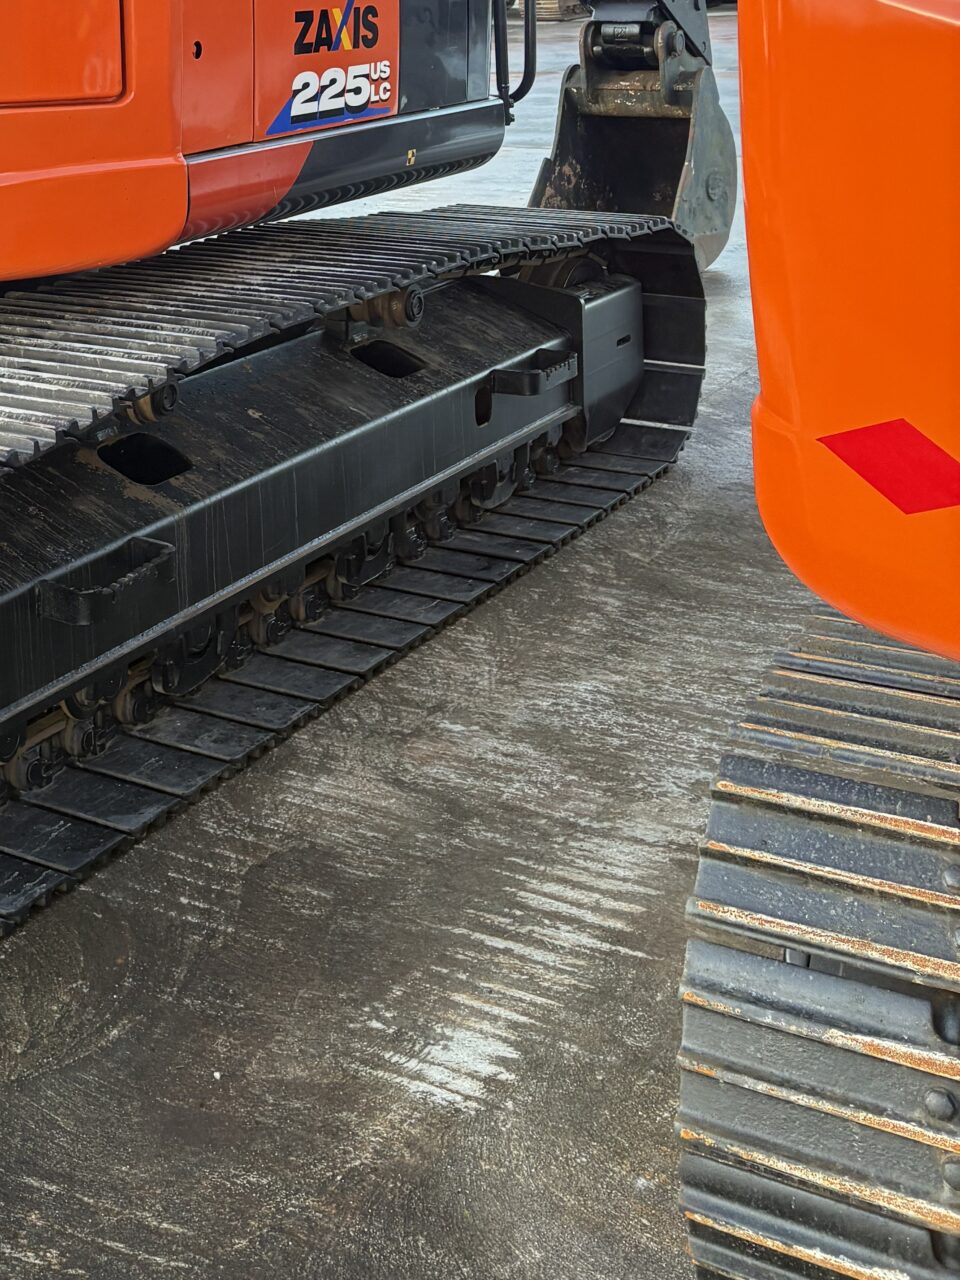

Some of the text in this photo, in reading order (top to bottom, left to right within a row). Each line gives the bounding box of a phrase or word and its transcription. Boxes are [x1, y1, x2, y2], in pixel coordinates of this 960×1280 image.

[290, 60, 391, 122] 225 US
[370, 82, 391, 103] LC
